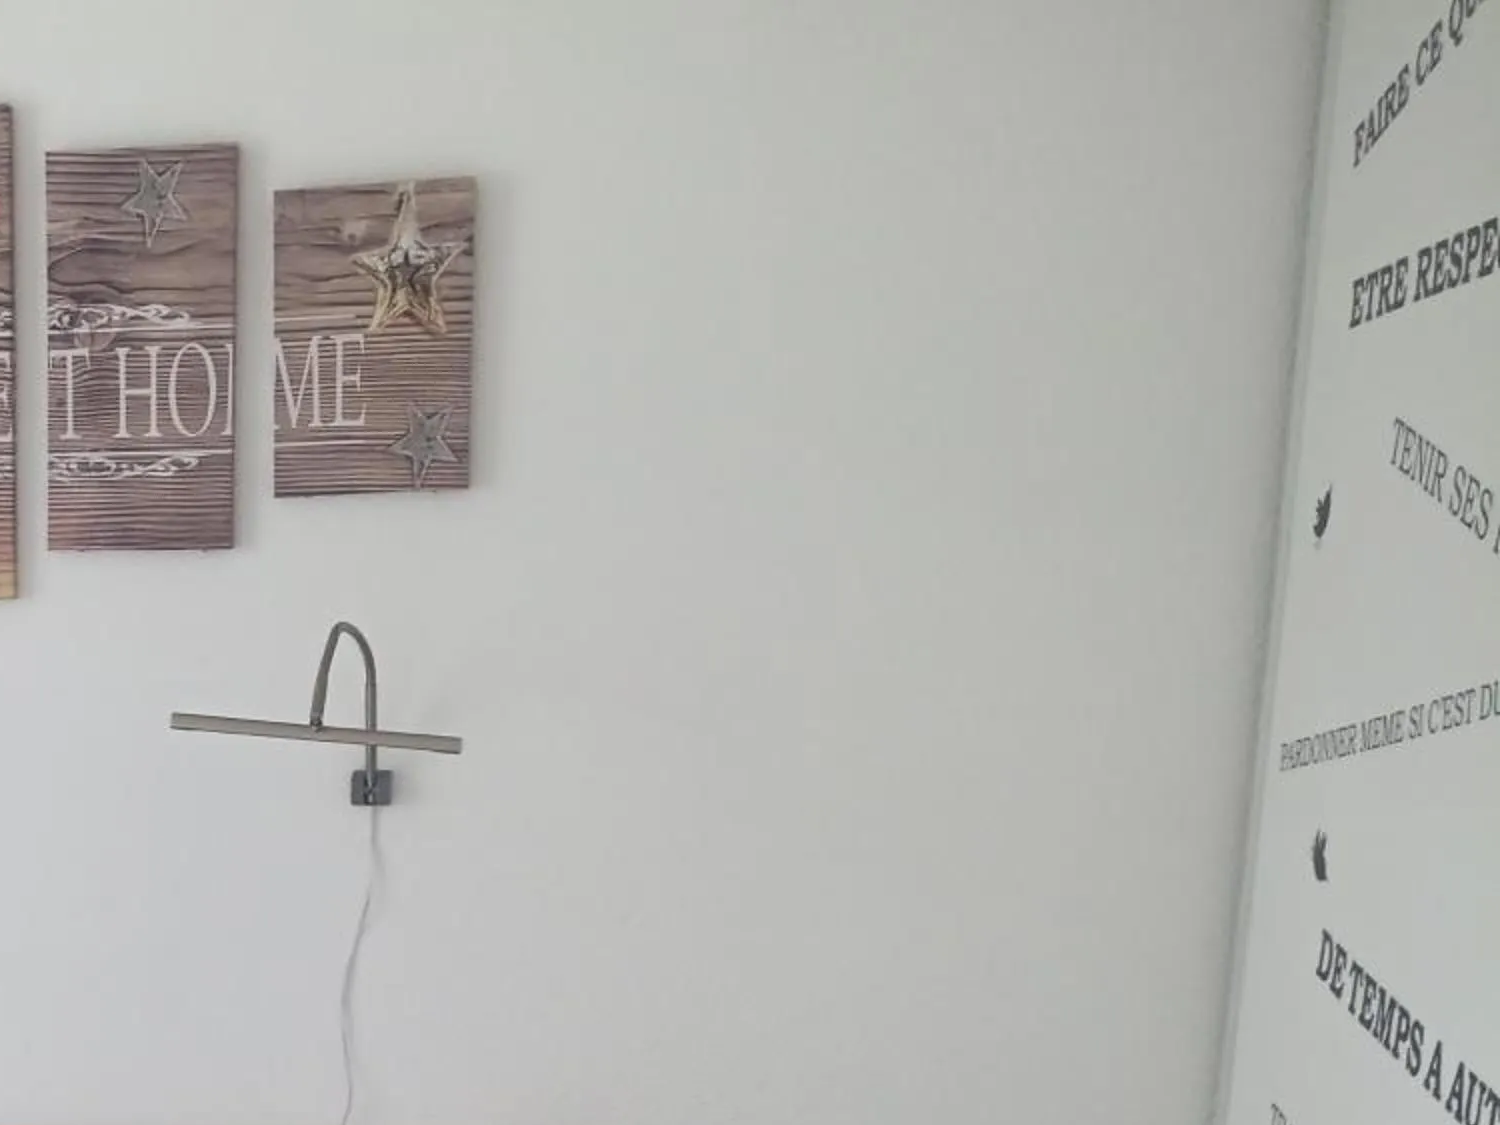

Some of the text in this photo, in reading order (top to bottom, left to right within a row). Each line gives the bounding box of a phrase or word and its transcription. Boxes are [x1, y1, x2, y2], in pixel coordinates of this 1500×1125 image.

[1353, 18, 1443, 168] FAIRE CE
[1349, 216, 1500, 329] ETRE RESPE
[1390, 416, 1494, 541] TENIR SES
[1359, 710, 1405, 752] MEME
[1408, 703, 1424, 740] SI
[1316, 928, 1347, 999] DE
[1348, 960, 1425, 1077] TEMPS
[1424, 1039, 1442, 1102] A
